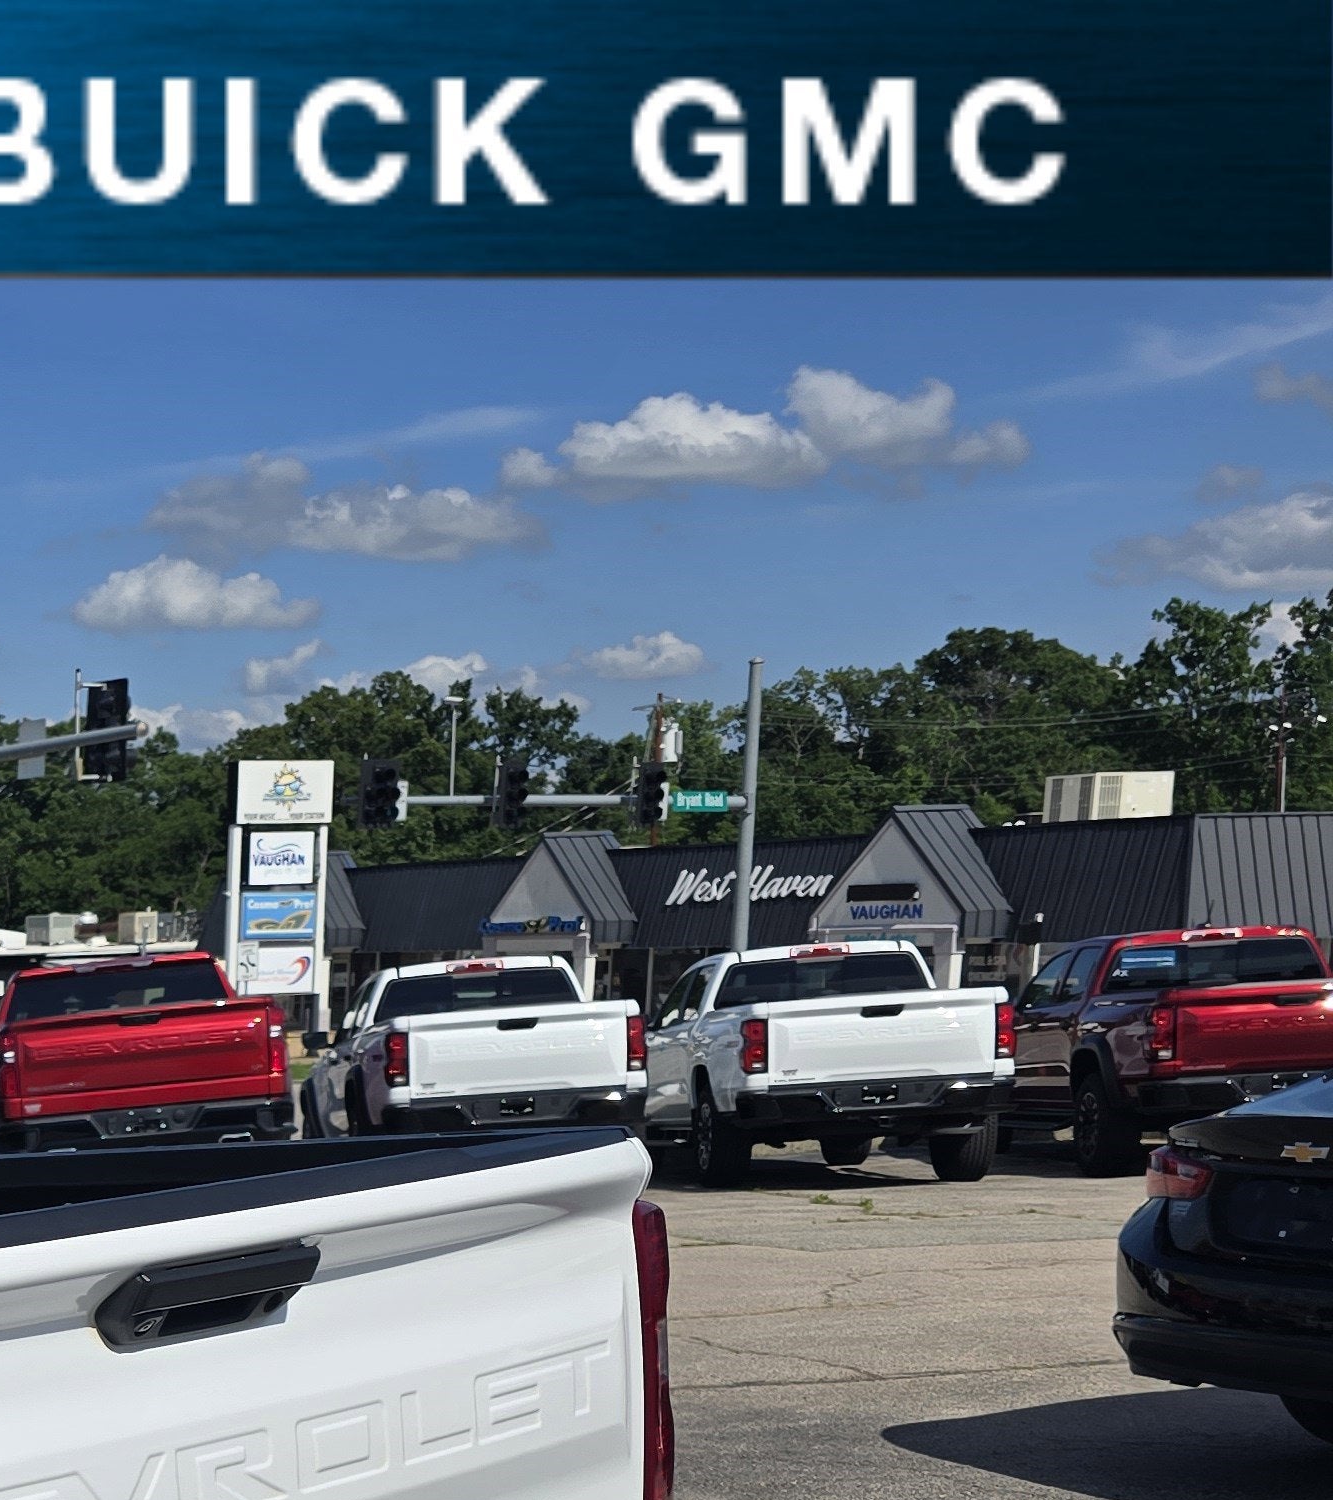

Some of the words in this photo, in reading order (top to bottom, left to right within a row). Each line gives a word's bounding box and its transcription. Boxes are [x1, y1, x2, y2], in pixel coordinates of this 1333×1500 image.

[252, 854, 305, 867] VAUGHAN
[665, 868, 737, 906] West
[748, 864, 834, 902] Haven
[850, 903, 923, 920] VAUGHAN
